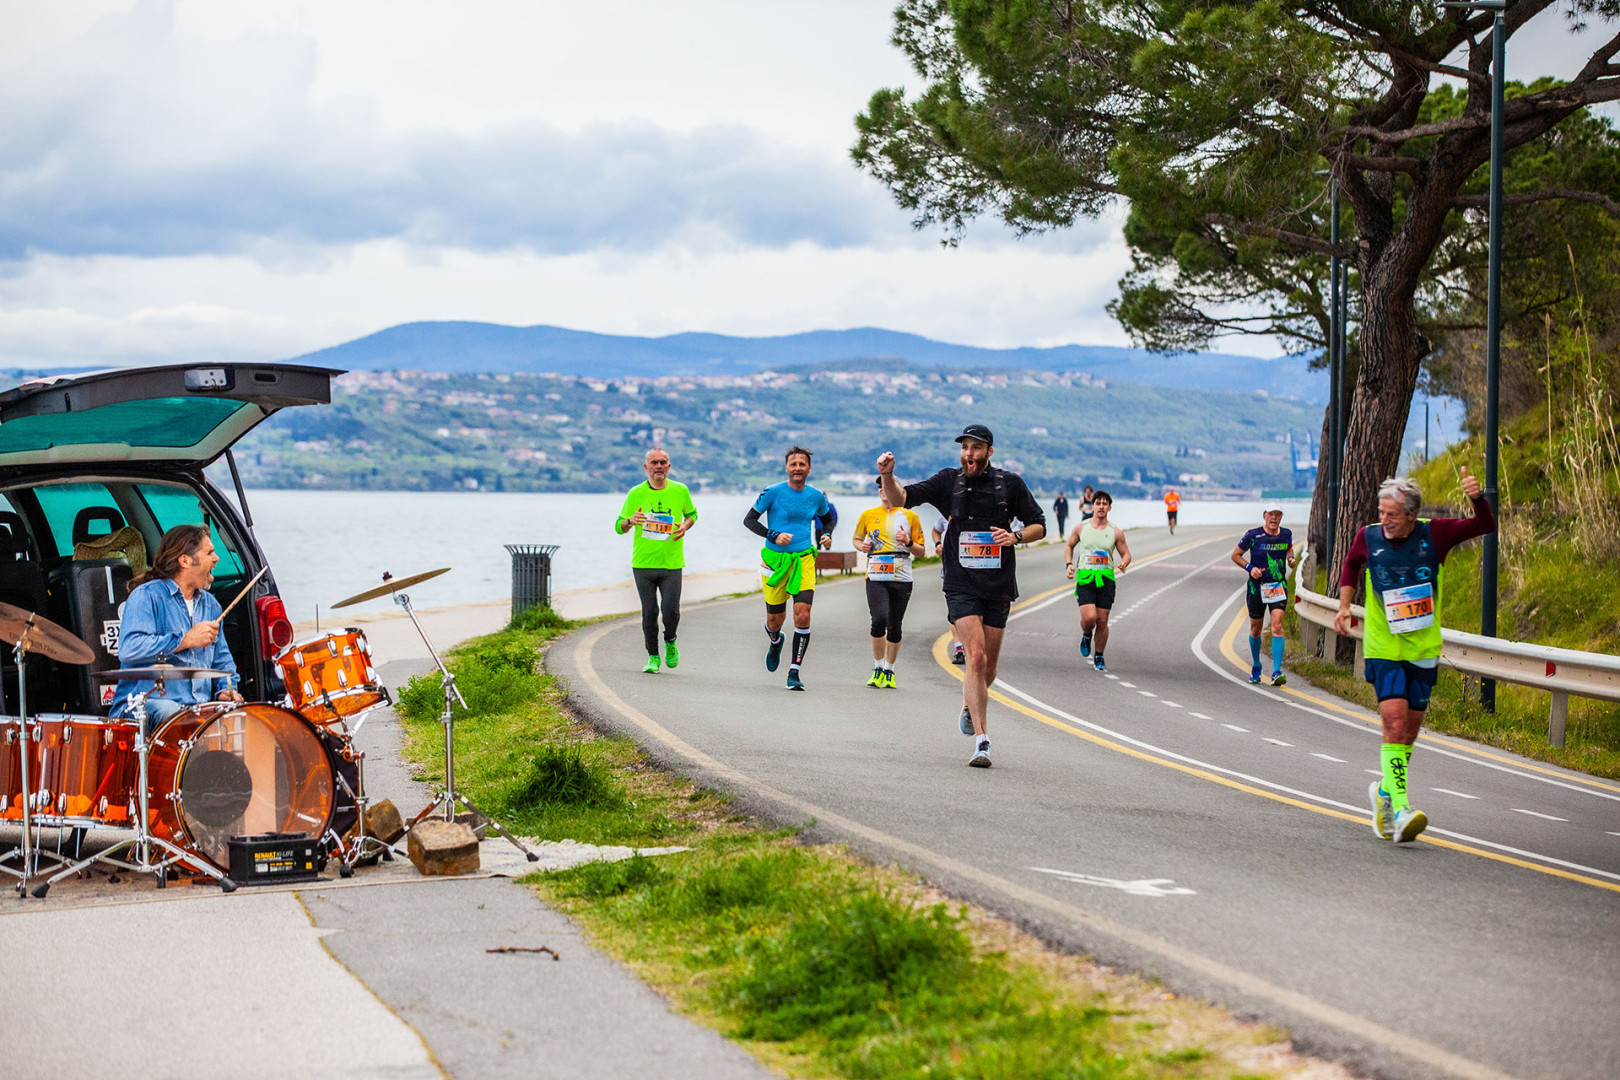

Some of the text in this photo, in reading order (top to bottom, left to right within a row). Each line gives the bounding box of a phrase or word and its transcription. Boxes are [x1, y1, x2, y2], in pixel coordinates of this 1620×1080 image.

[979, 545, 992, 555] 78
[879, 564, 889, 572] 47
[1406, 601, 1428, 616] 170
[1390, 757, 1408, 795] eleven
[254, 851, 276, 859] RENAULT
